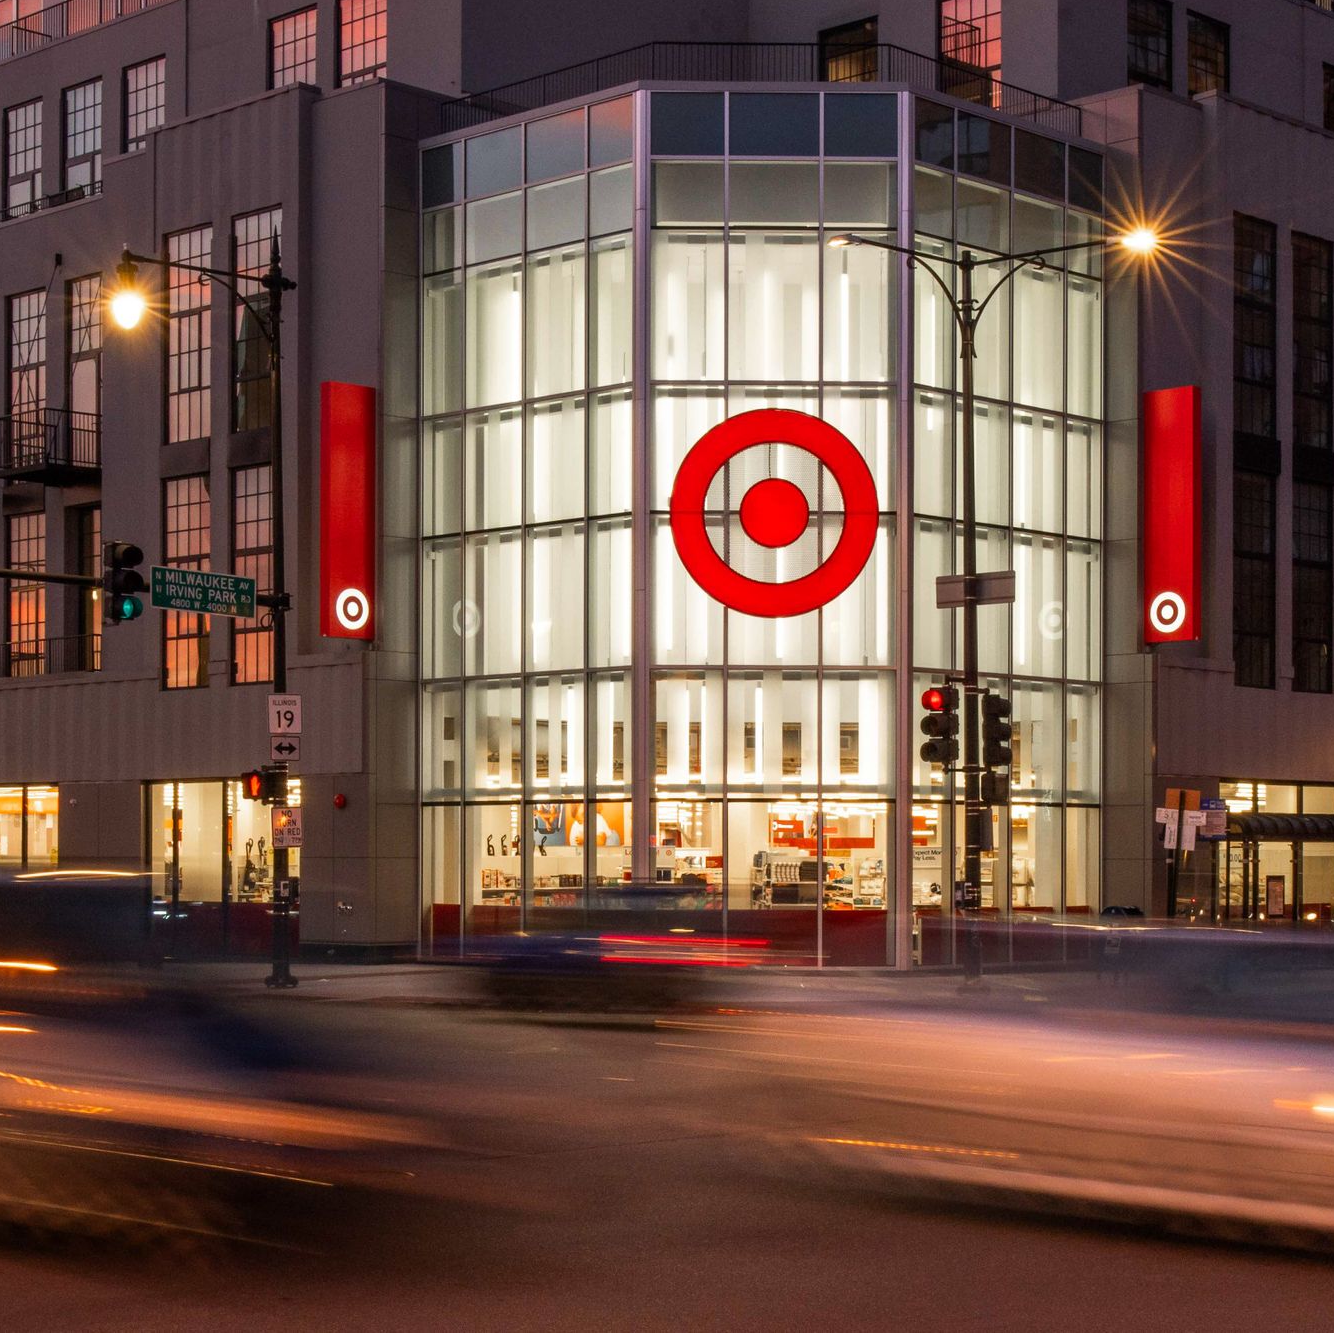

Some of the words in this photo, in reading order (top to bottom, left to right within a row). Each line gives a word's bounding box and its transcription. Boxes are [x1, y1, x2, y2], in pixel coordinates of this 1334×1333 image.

[155, 571, 162, 580] N
[165, 571, 235, 591] MILWAUKEE
[239, 581, 250, 590] AV
[166, 584, 202, 600] IRVING
[208, 589, 237, 604] PARK
[240, 595, 251, 604] RD
[170, 598, 191, 609] 4800
[193, 601, 200, 610] W
[206, 602, 228, 613] 4000
[276, 710, 294, 728] 19
[281, 810, 292, 818] NO
[274, 828, 284, 836] ON
[287, 827, 301, 836] RED
